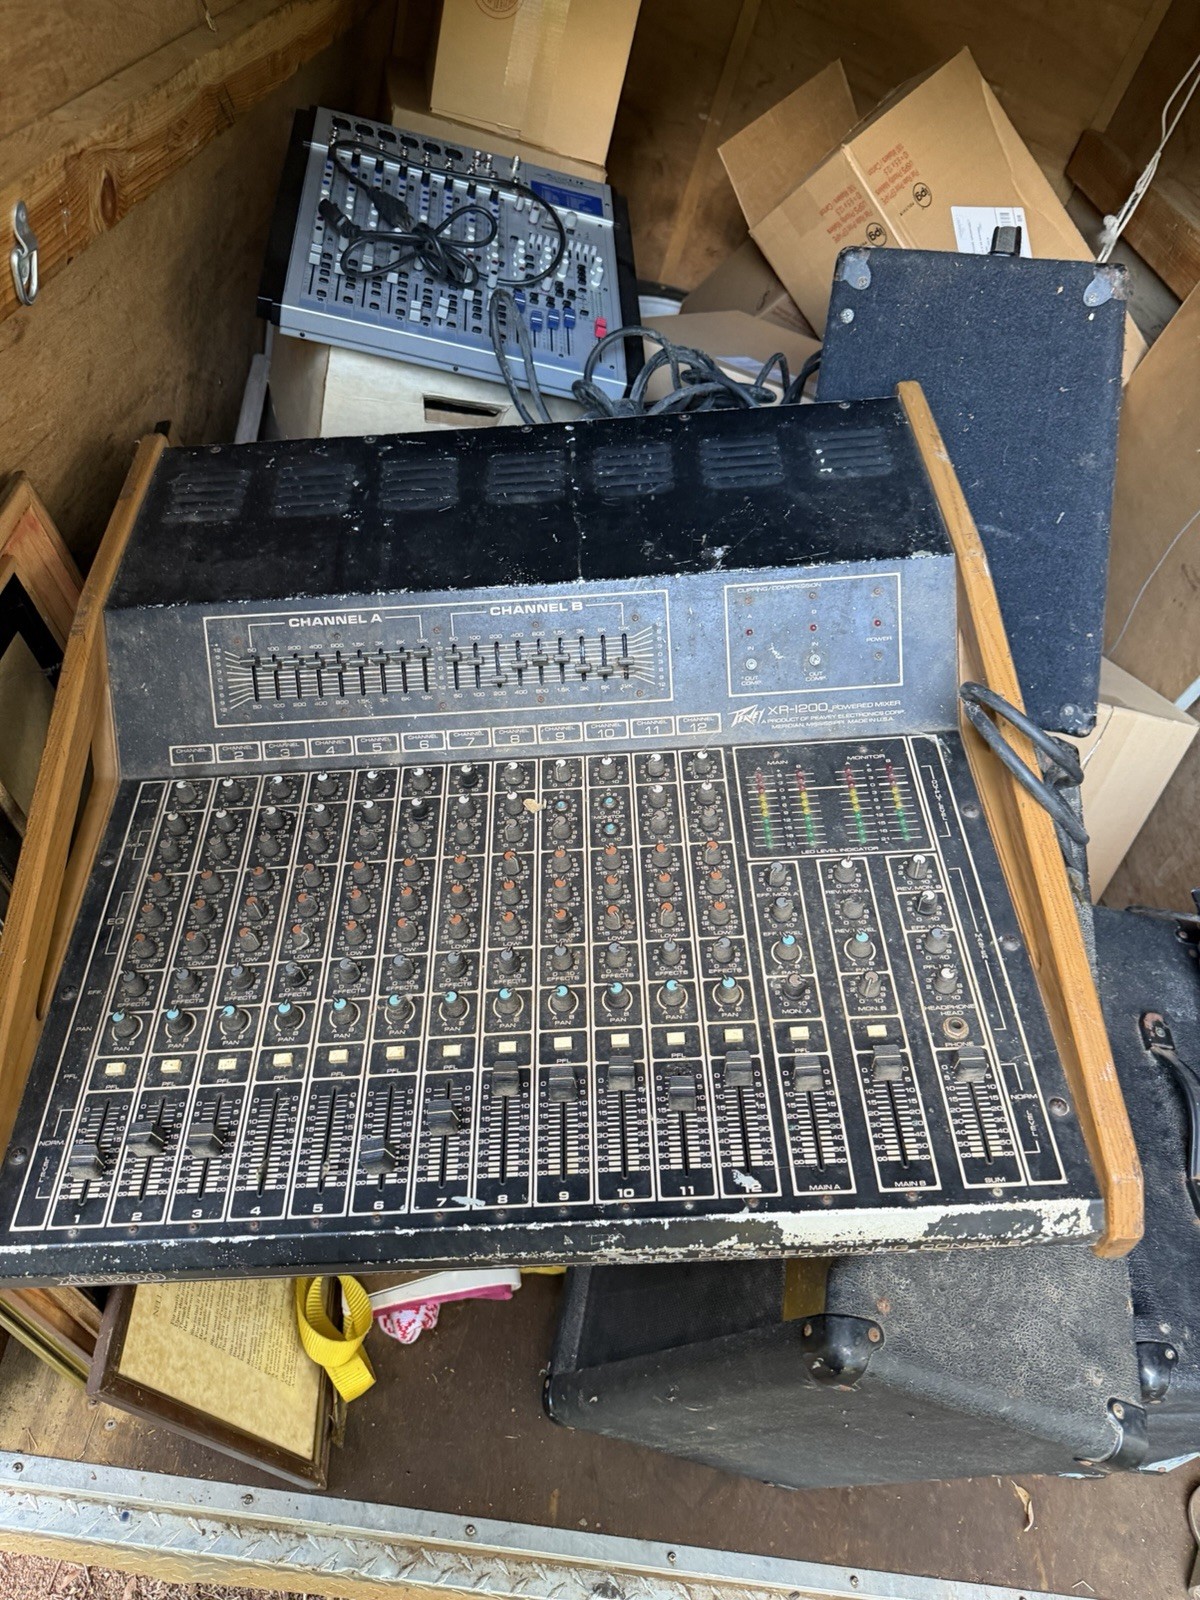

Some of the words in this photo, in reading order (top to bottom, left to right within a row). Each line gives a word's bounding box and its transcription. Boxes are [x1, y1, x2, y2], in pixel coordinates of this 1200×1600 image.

[490, 603, 564, 616] CHANNEL
[567, 602, 582, 611] B
[288, 615, 368, 627] CHANNEL
[370, 613, 382, 622] A
[768, 702, 828, 716] XR-1200
[833, 702, 873, 710] POWERED
[645, 726, 660, 735] 11
[690, 723, 707, 732] 12
[555, 732, 565, 740] 9
[597, 729, 615, 738] 10
[466, 737, 474, 746] 7
[510, 735, 520, 744] 8
[372, 743, 382, 752] 5
[419, 740, 429, 749] 6
[280, 750, 290, 758] 3
[326, 746, 335, 755] 4
[189, 754, 195, 763] 1
[234, 752, 244, 761] 2
[107, 918, 124, 926] EQ
[617, 1188, 635, 1198] 10
[680, 1186, 695, 1195] 11
[497, 1195, 508, 1204] 8
[558, 1191, 570, 1200] 9
[374, 1201, 384, 1210] 6
[437, 1198, 447, 1207] 7
[250, 1206, 261, 1215] 4
[312, 1204, 324, 1213] 5
[131, 1212, 143, 1221] 2
[192, 1209, 203, 1218] 3
[74, 1214, 80, 1224] 1
